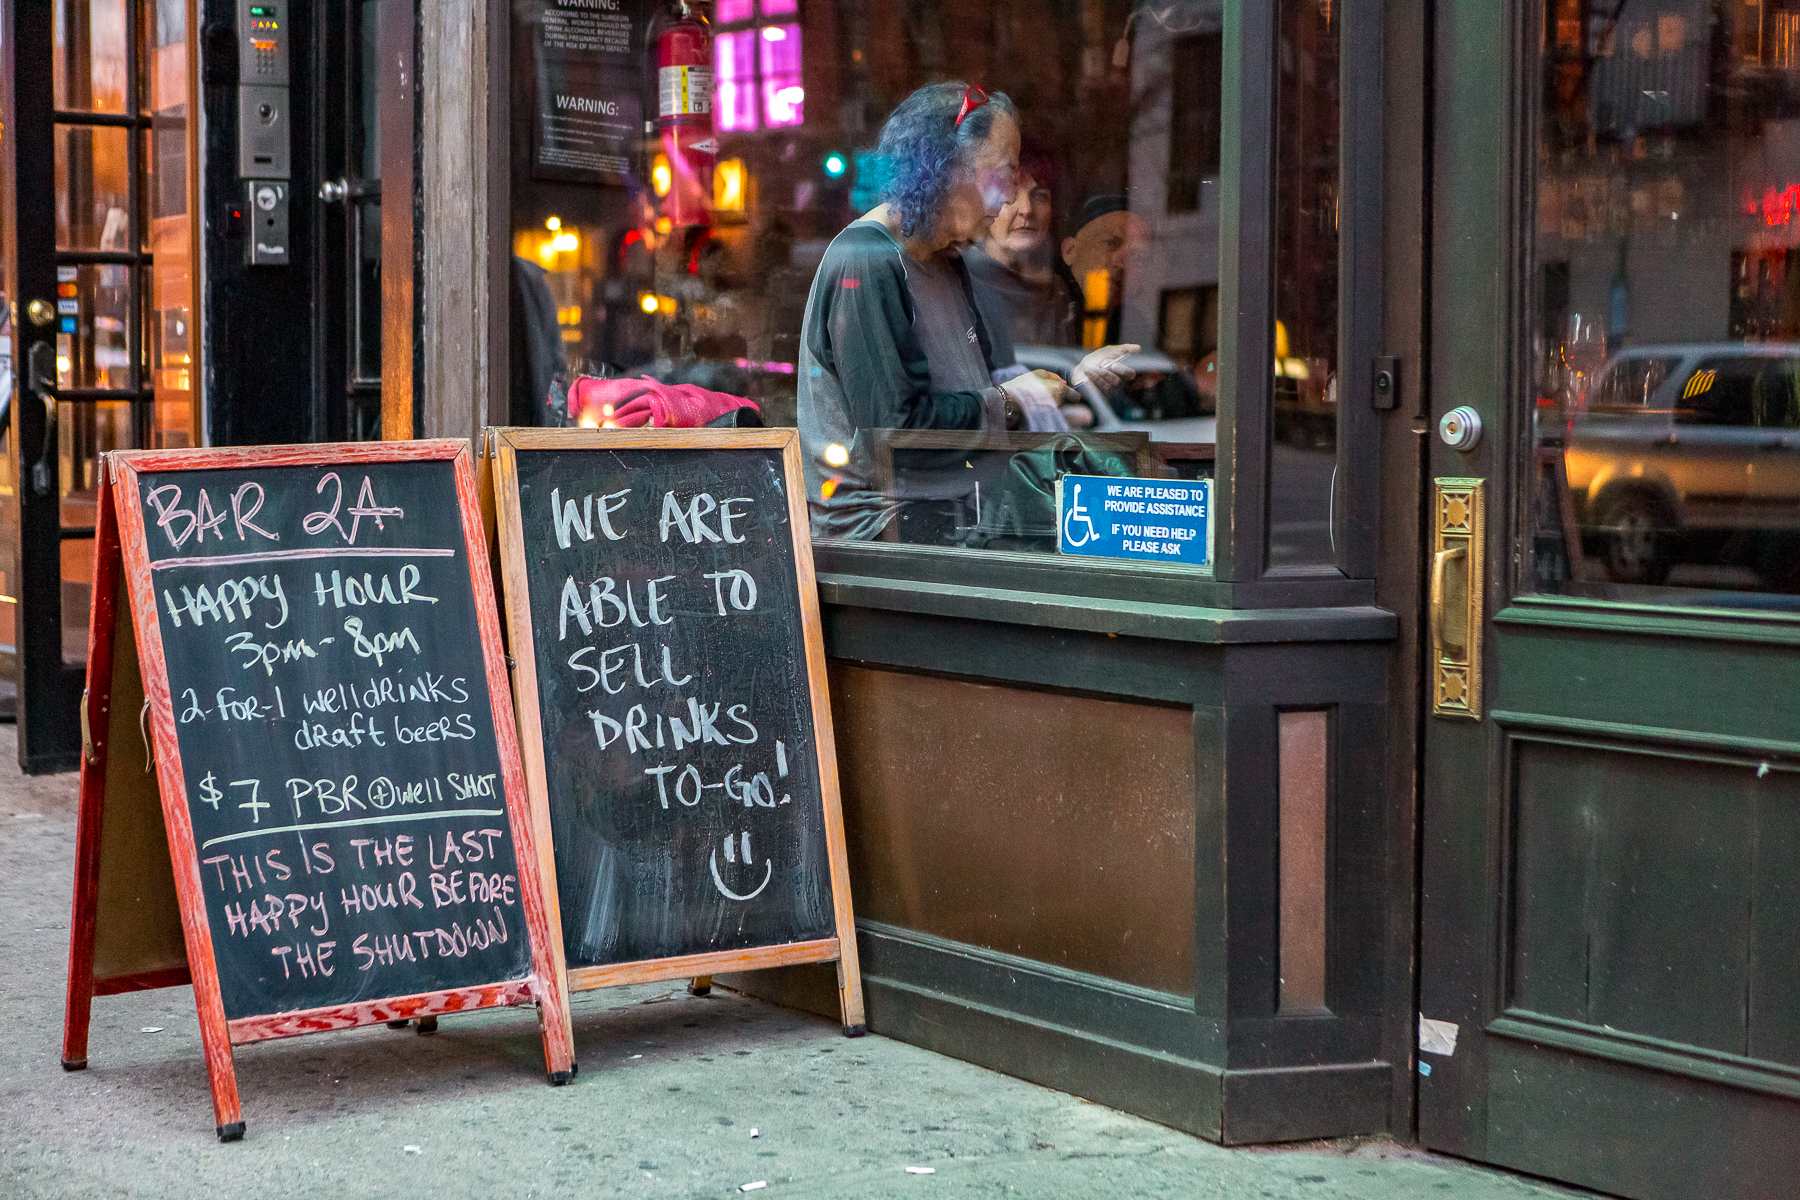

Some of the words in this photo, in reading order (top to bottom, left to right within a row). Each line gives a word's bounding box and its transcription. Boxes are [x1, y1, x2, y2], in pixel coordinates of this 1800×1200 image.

[556, 94, 619, 116] WARNING:
[146, 481, 280, 552] BAR
[302, 471, 404, 546] 2A
[550, 486, 633, 550] WE
[659, 490, 755, 544] ARE
[1104, 500, 1145, 514] PROVIDE
[1146, 502, 1205, 518] ASSISTANCE
[1107, 485, 1122, 497] WE
[1123, 486, 1144, 498] ARE
[1144, 487, 1188, 501] PLEASED
[1190, 489, 1204, 502] TO
[1112, 523, 1121, 535] IF
[1122, 524, 1142, 537] YOU
[1143, 526, 1169, 539] NEED
[1170, 528, 1197, 541] HELP
[1122, 539, 1160, 554] PLEASE
[1160, 542, 1181, 556] ASK
[163, 572, 289, 630] HAPPY
[313, 563, 440, 609] HOUR
[558, 574, 677, 641] ABLE
[703, 568, 758, 616] TO
[567, 642, 693, 695] SELL
[585, 696, 759, 755] DRINKS
[286, 774, 368, 819] PBR
[447, 771, 498, 802] SHOT
[202, 848, 292, 894] THIS
[301, 838, 336, 875] IS
[349, 834, 414, 870] THE
[429, 829, 503, 870] LAST
[224, 891, 330, 938] HAPPY
[342, 871, 424, 916] HOUR
[429, 870, 517, 909] BEFORE
[271, 940, 337, 980] THE
[352, 906, 508, 972] SHUTDOWN
